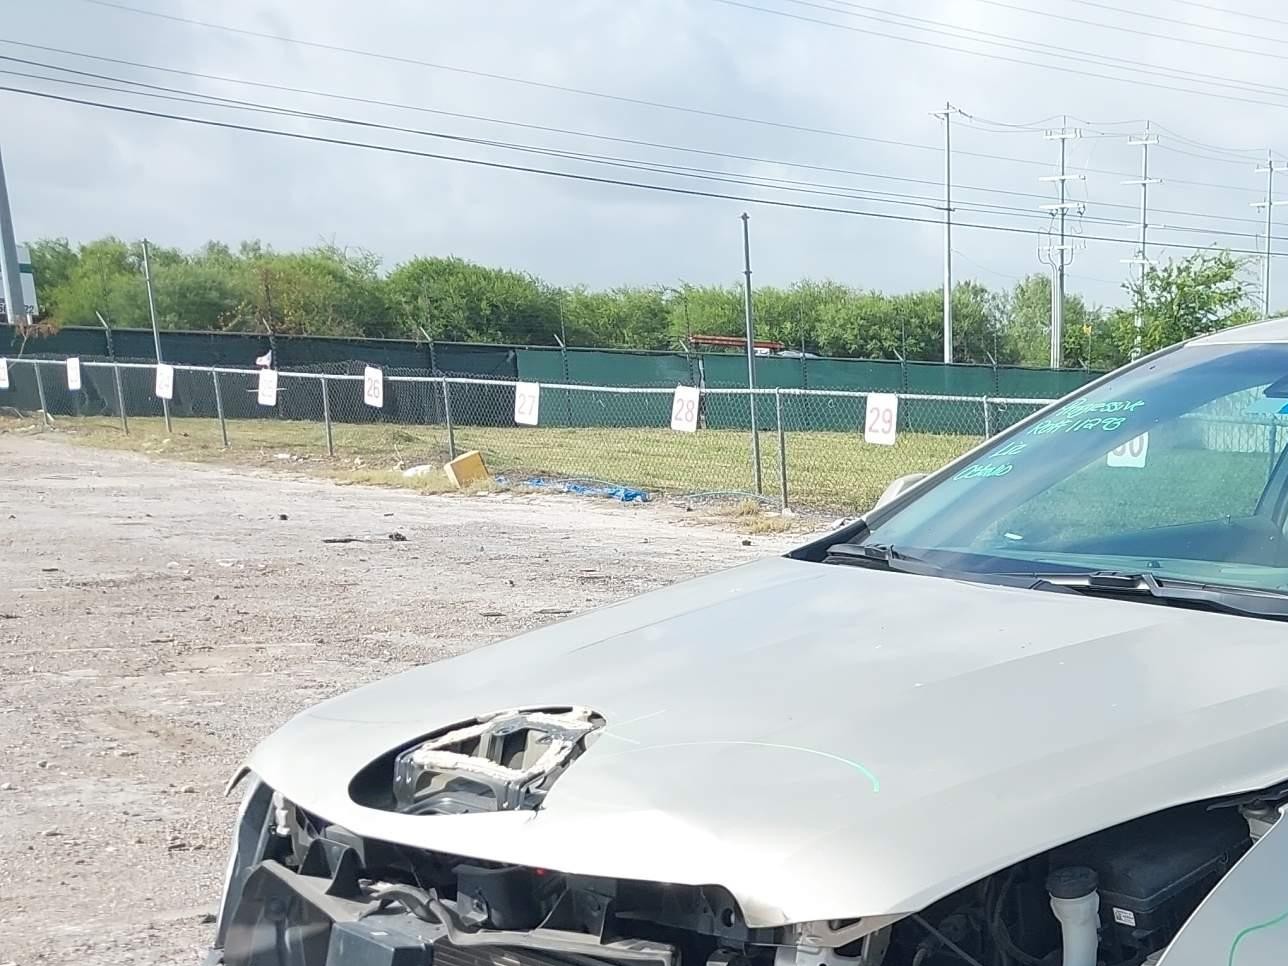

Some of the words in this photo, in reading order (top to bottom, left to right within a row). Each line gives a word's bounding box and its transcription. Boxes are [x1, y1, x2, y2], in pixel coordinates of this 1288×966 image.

[367, 377, 380, 399] 26
[517, 392, 537, 416] 27
[674, 398, 696, 423] 28
[868, 406, 894, 435] 29
